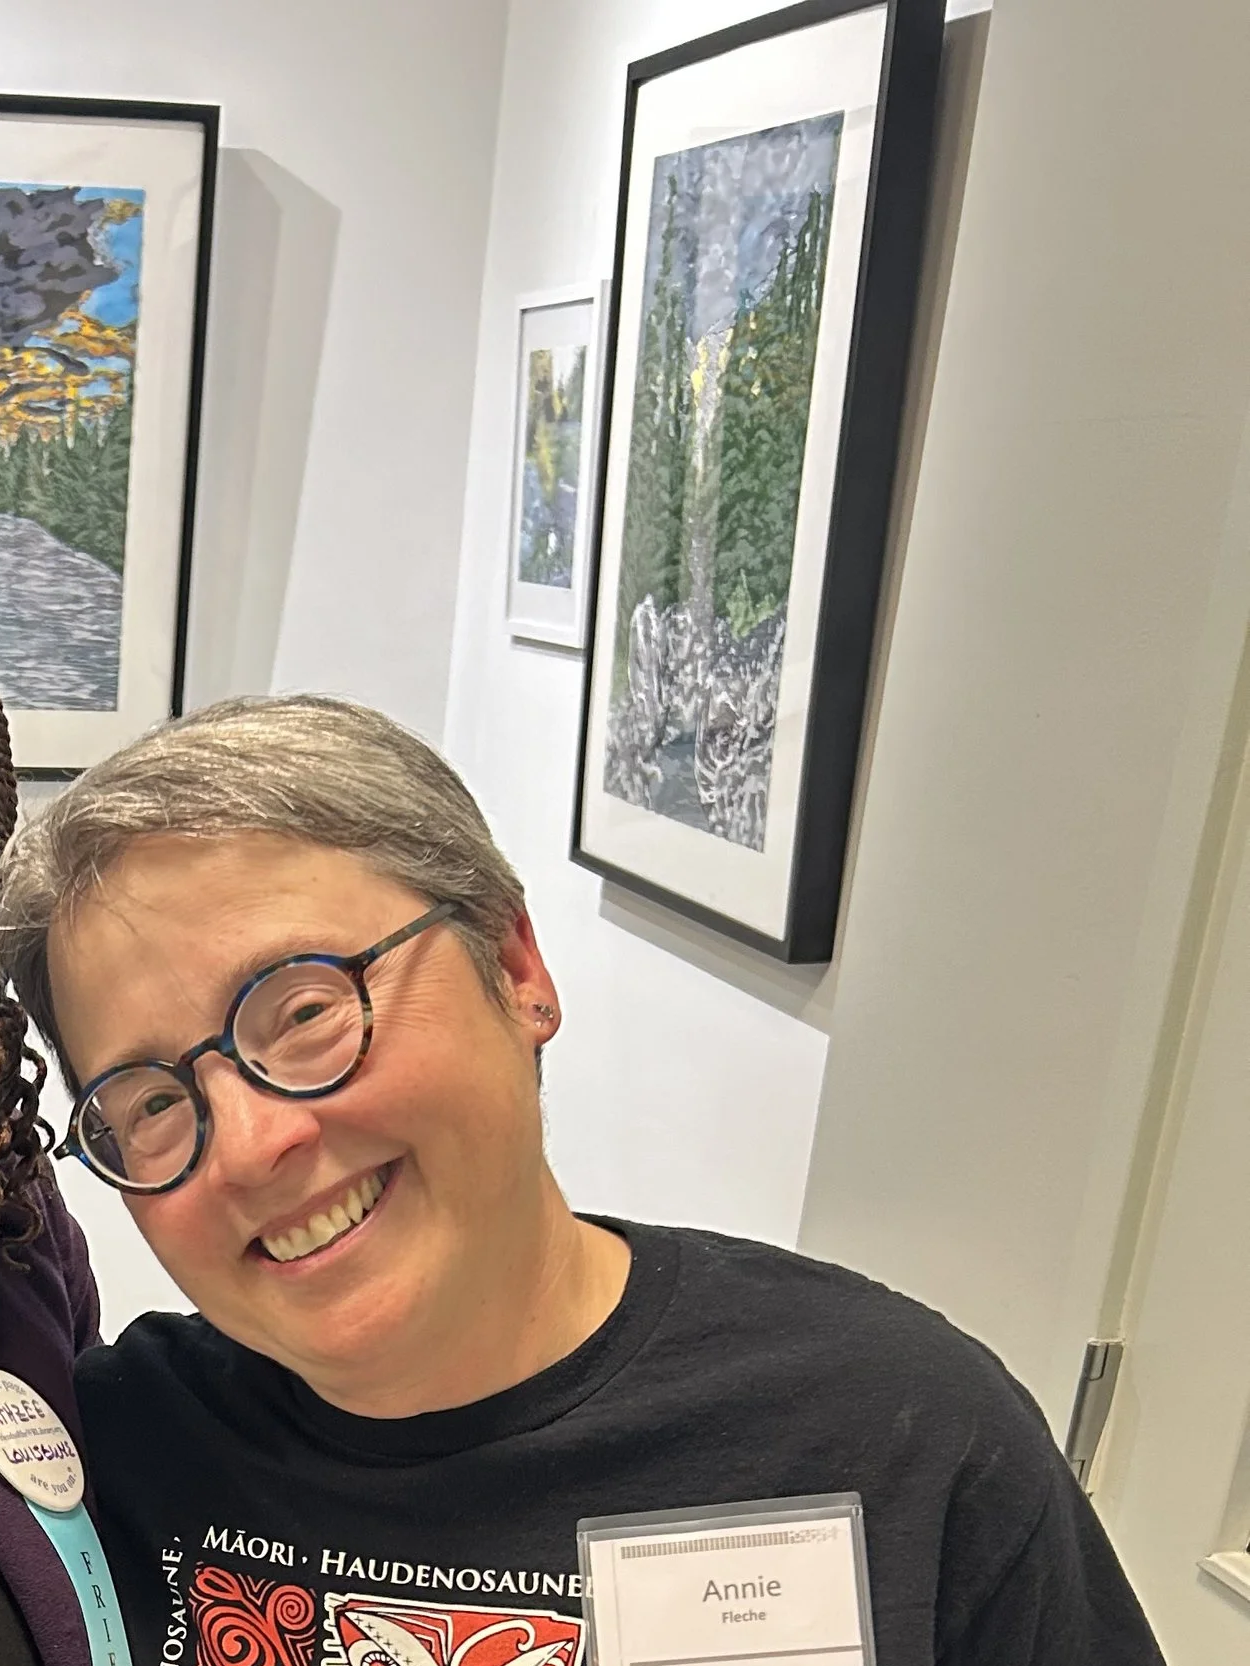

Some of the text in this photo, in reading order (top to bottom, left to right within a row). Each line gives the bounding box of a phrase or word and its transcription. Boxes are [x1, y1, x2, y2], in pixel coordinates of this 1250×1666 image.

[30, 1473, 49, 1491] are
[50, 1482, 68, 1496] you
[202, 1525, 294, 1566] MĀORI
[702, 1575, 782, 1602] Annie
[721, 1608, 767, 1624] Fleche
